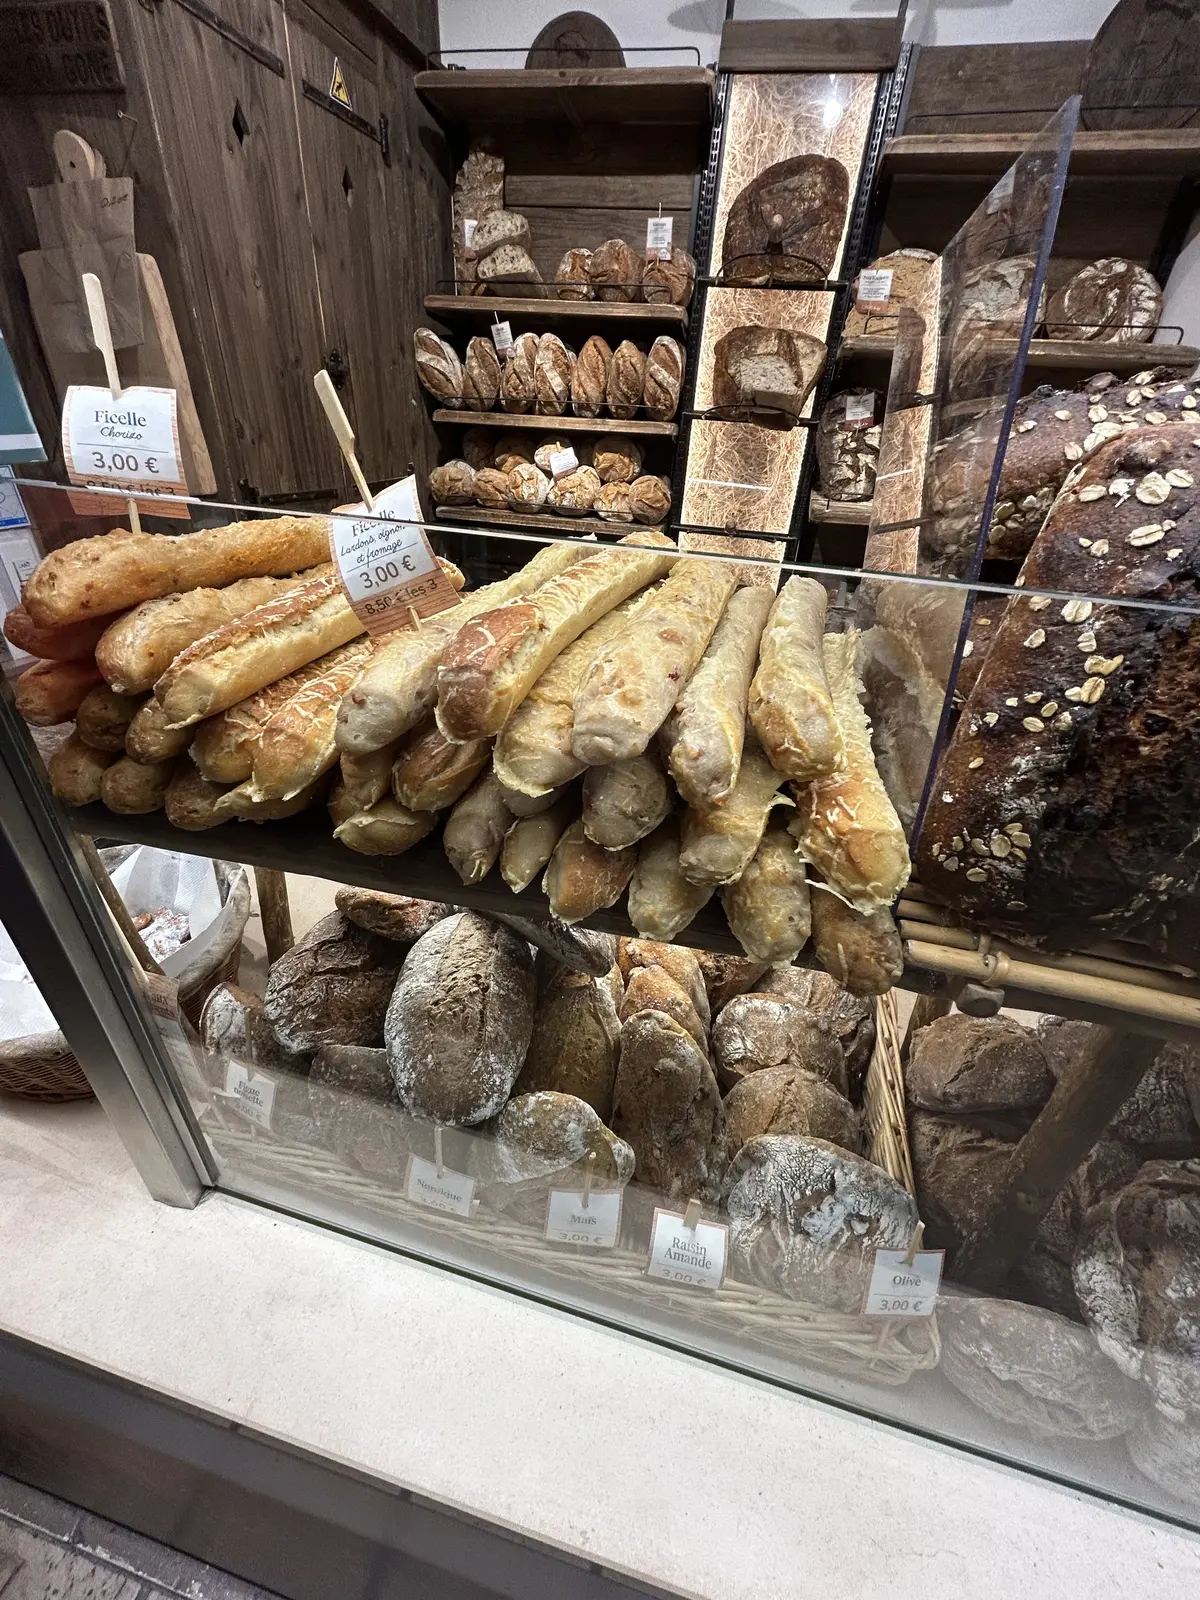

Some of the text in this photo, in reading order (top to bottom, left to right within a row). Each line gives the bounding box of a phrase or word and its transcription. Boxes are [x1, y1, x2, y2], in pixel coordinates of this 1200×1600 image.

[94, 410, 147, 427] Ficelle
[100, 426, 143, 440] Chorizo
[92, 451, 159, 474] 3,00 €
[341, 535, 377, 556] Lardons,
[357, 539, 402, 568] et fromage
[359, 555, 416, 589] 3,00 €
[364, 595, 396, 615] 8,50
[406, 584, 426, 599] les
[427, 578, 438, 591] 3
[559, 1232, 603, 1245] 3,00 €
[672, 1236, 707, 1256] Raisin
[663, 1247, 712, 1270] Amande
[662, 1268, 692, 1283] 3,00
[893, 1275, 921, 1287] Olive
[879, 1299, 923, 1312] 3,00 €
